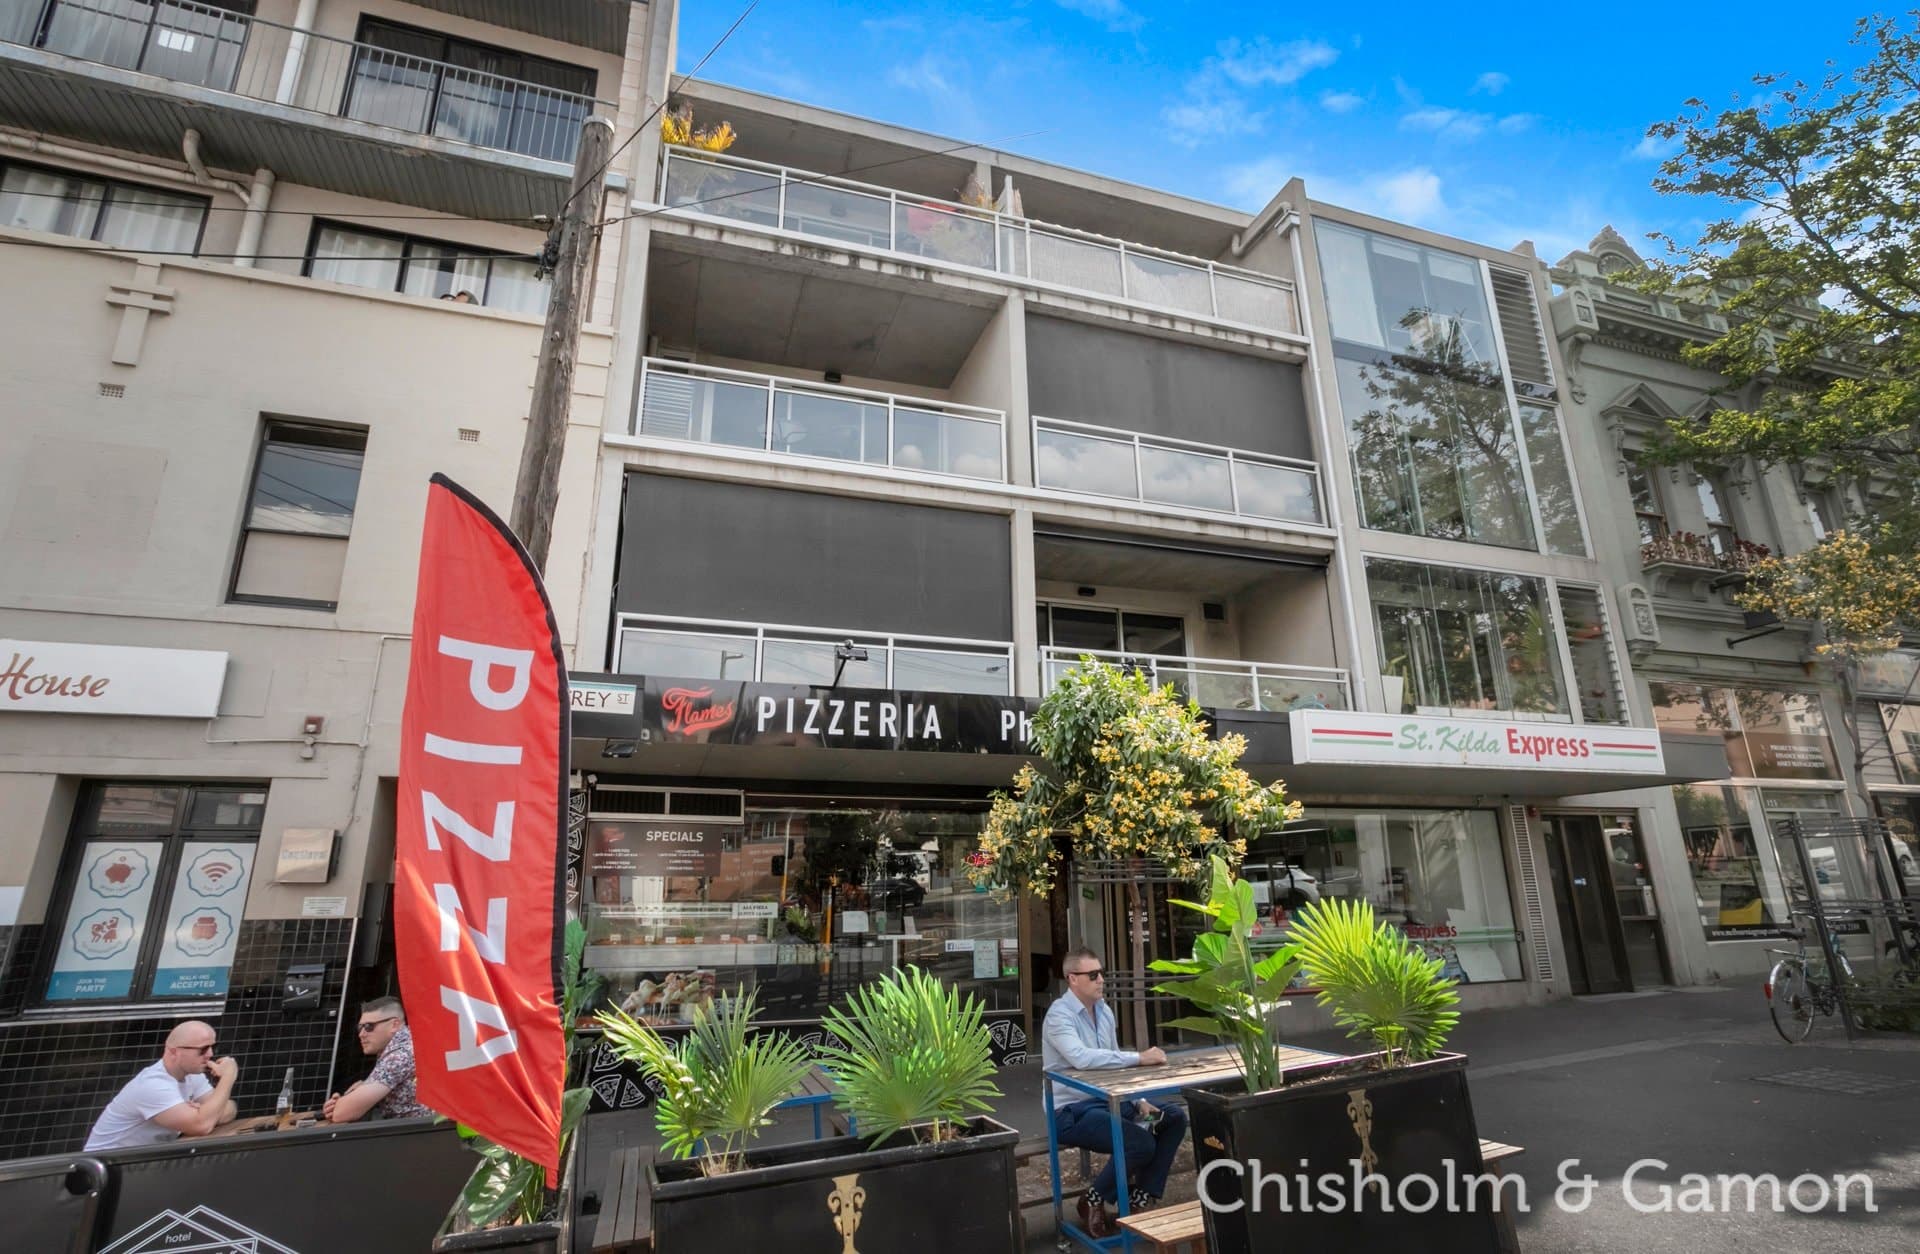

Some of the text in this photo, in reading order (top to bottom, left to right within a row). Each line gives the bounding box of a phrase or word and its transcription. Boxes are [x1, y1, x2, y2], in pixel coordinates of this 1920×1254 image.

[0, 653, 110, 701] House
[569, 690, 630, 708] REY ST
[661, 686, 736, 736] Flames
[757, 696, 942, 740] PIZZERIA
[1506, 728, 1590, 762] Express
[645, 830, 704, 843] SPECIALS
[421, 635, 535, 1072] PIZZA
[75, 984, 106, 993] PARTY
[170, 979, 216, 990] ACCEPTED
[165, 1231, 192, 1244] hotel
